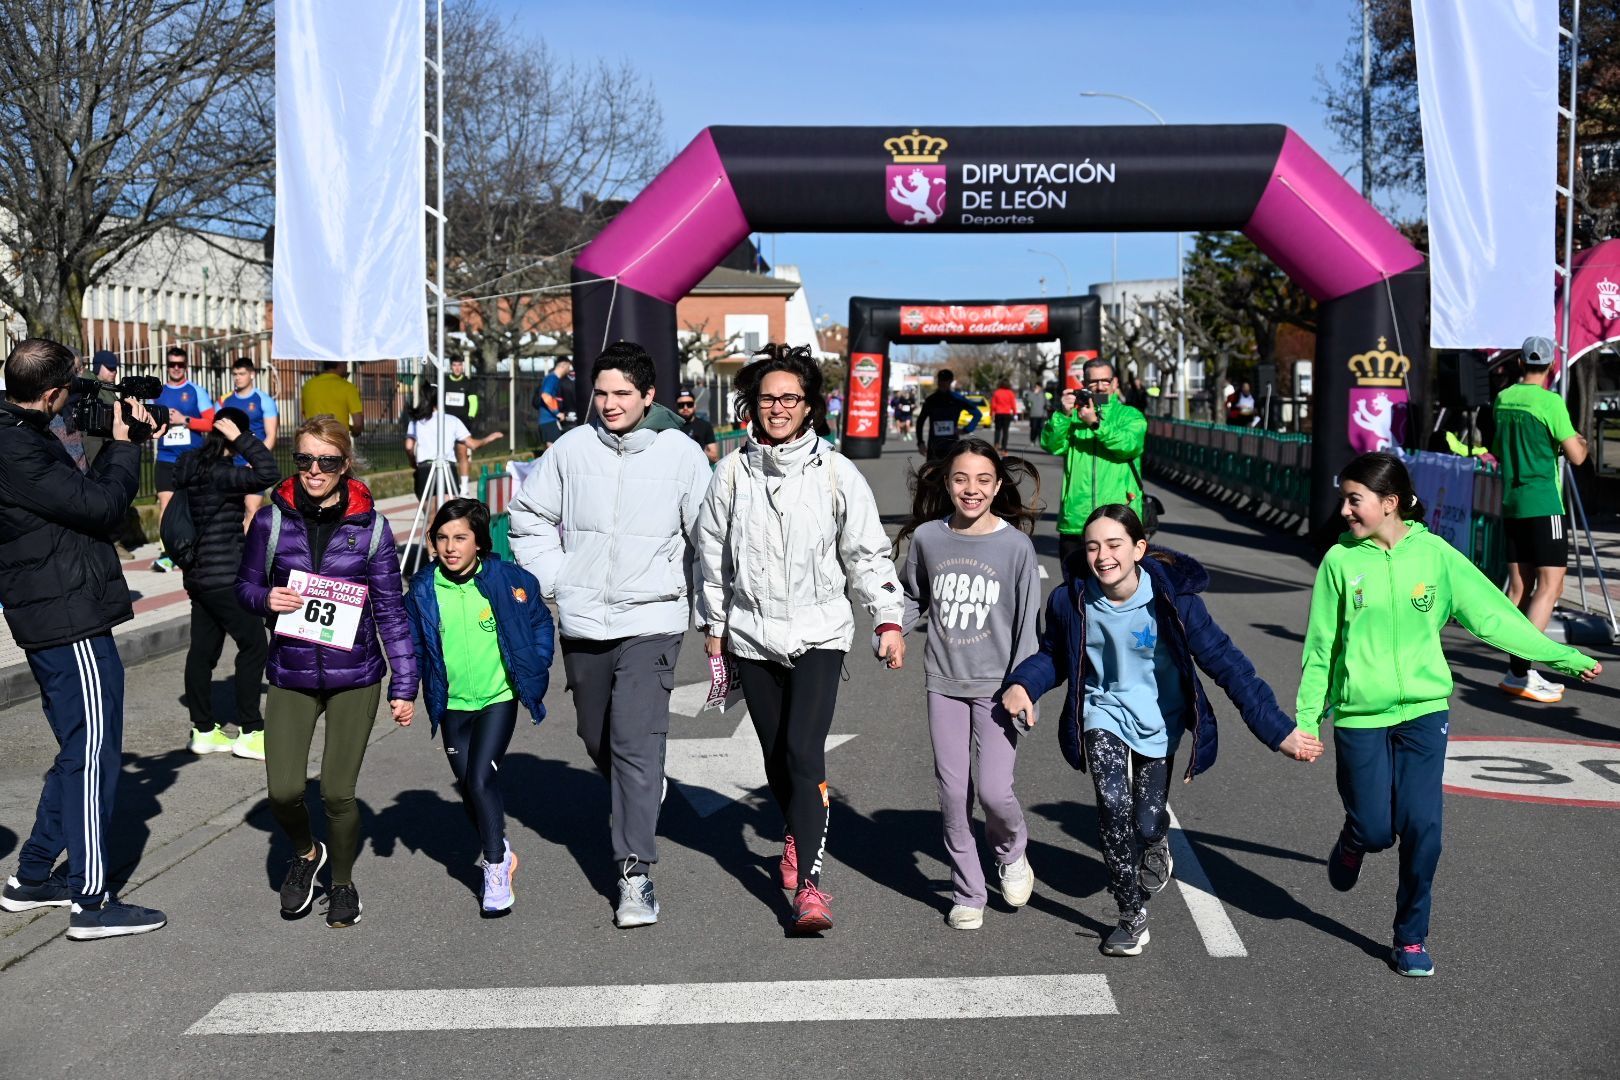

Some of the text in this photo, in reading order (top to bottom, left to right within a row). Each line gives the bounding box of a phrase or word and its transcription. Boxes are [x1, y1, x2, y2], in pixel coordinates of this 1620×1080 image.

[962, 158, 1115, 184] DIPUTACIÓN
[962, 185, 1067, 209] DE LEÓN
[961, 213, 1034, 226] Deportes
[167, 432, 185, 440] 475
[307, 587, 362, 605] PARA TODOS
[308, 576, 366, 596] DEPORTE
[932, 573, 1000, 605] URBAN
[304, 599, 337, 627] 63
[940, 600, 991, 630] CITY
[710, 657, 723, 699] DEPORTE
